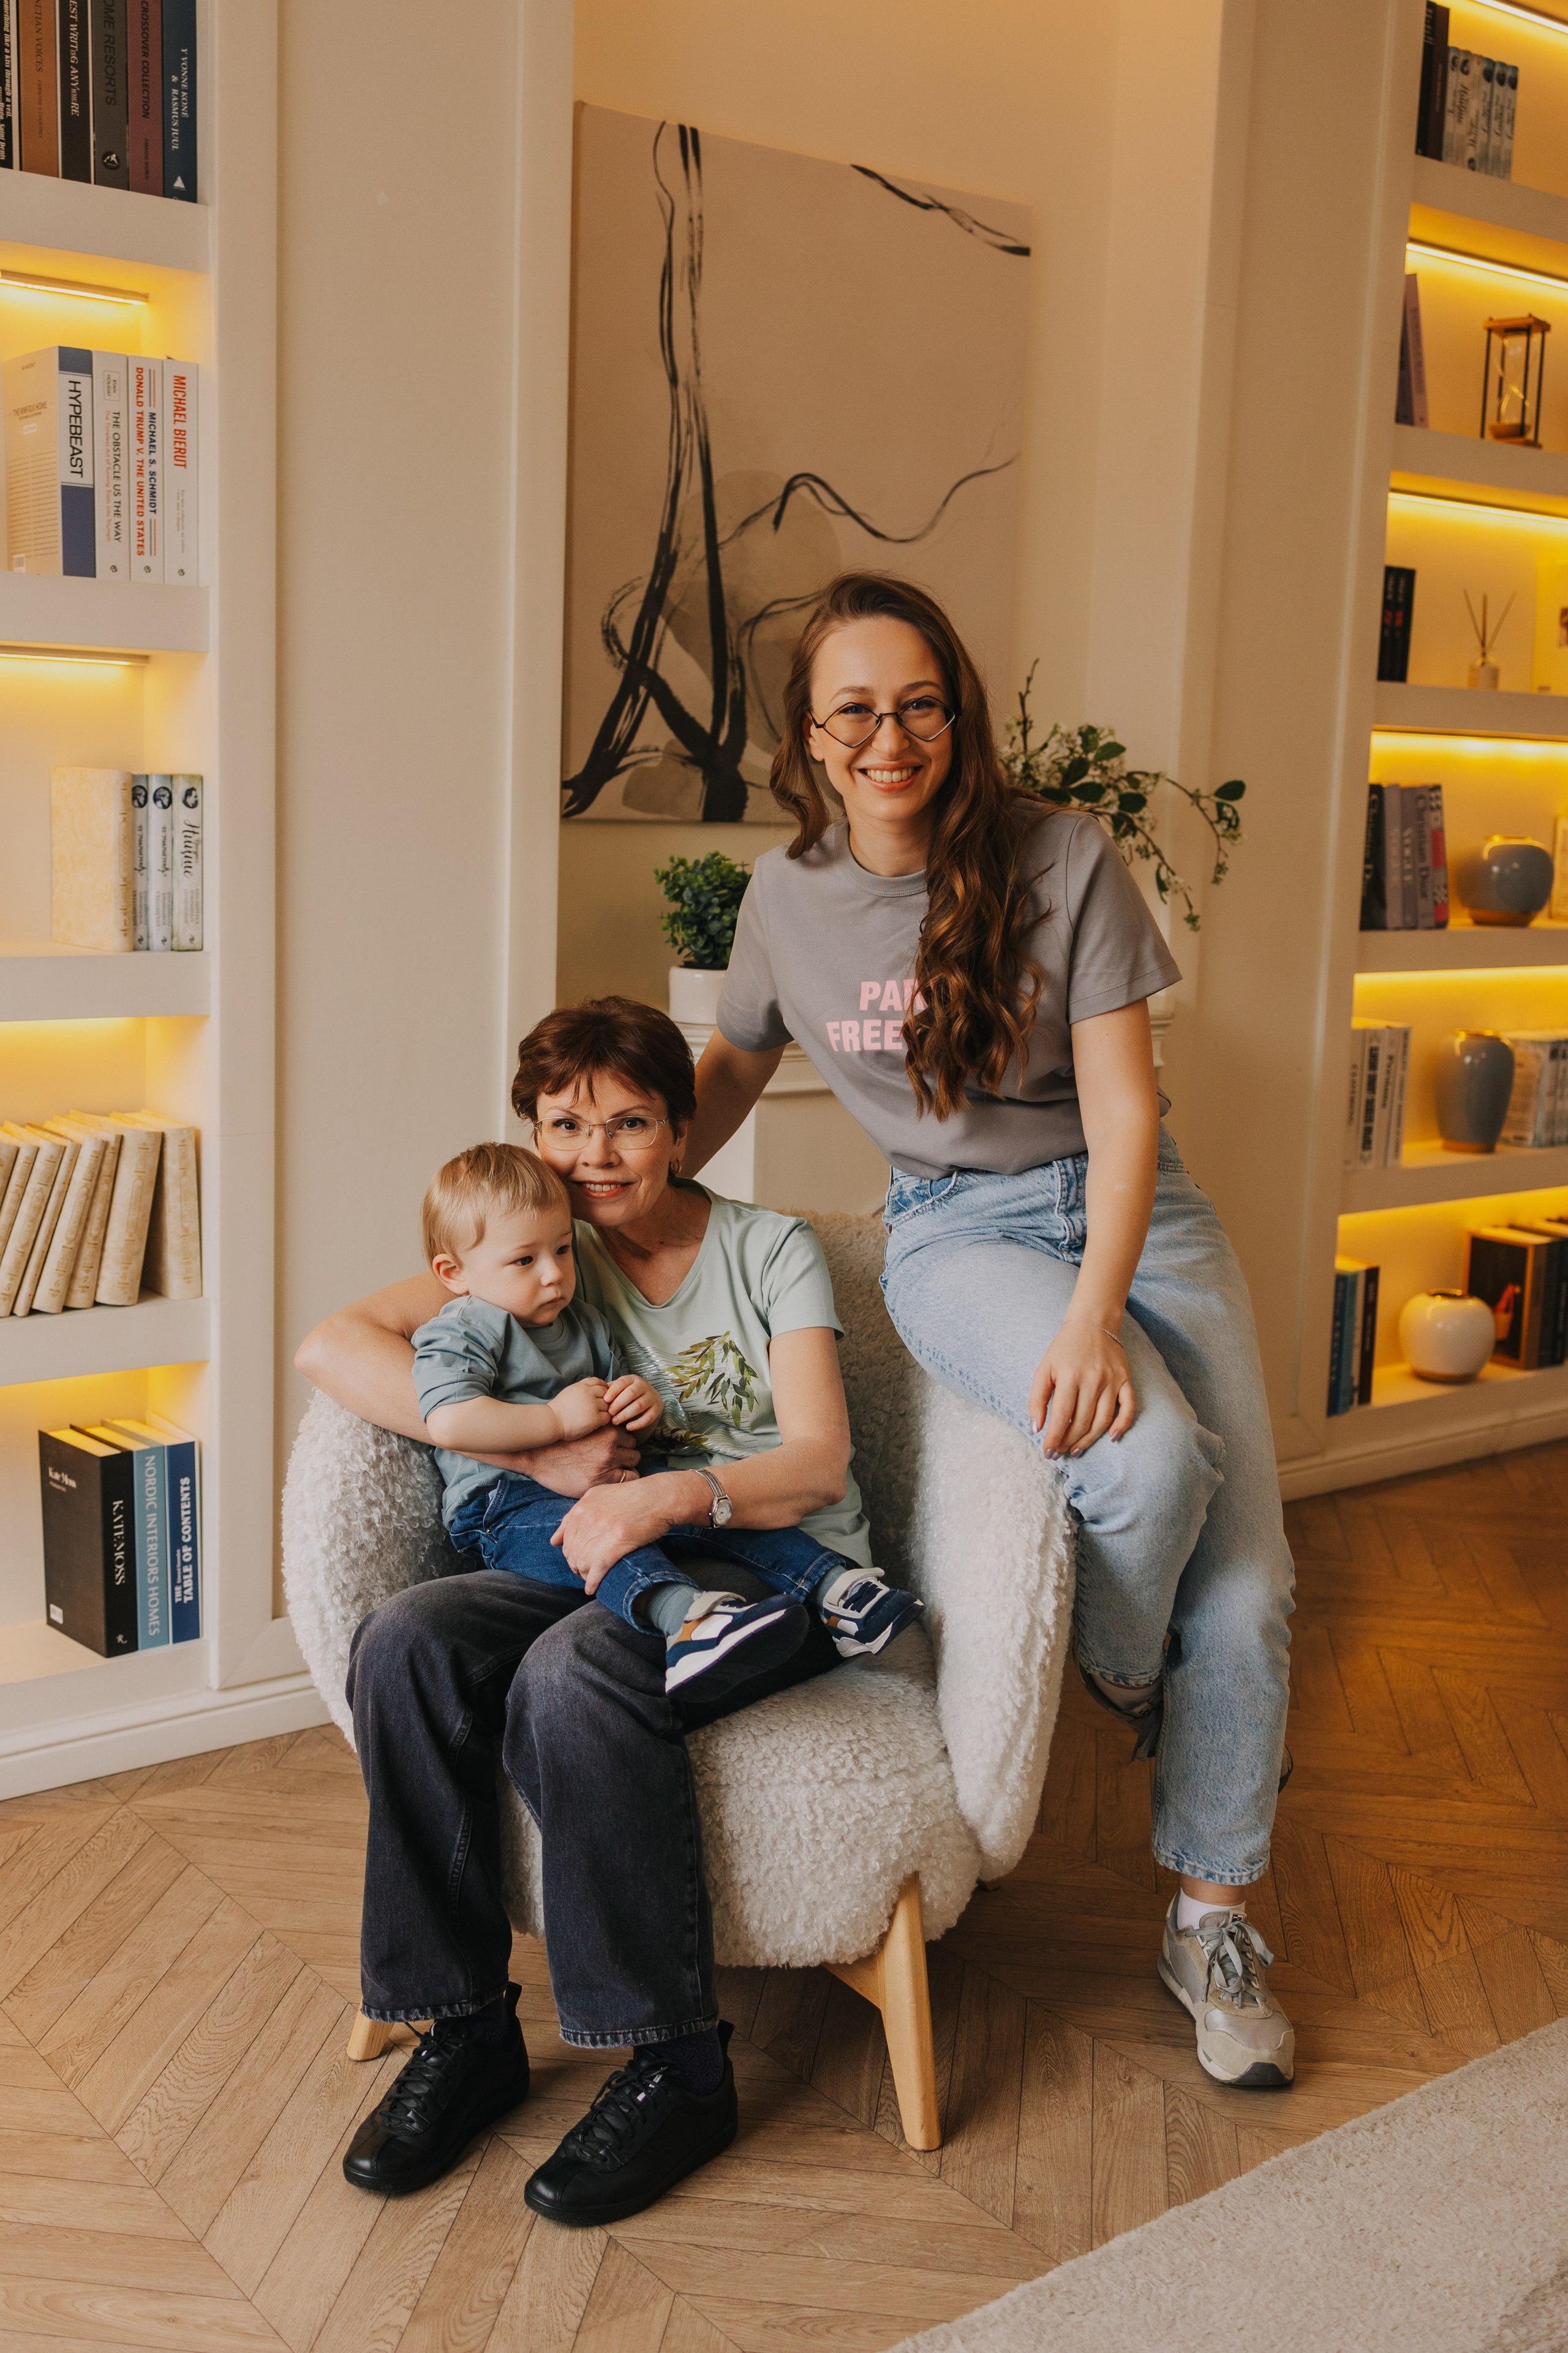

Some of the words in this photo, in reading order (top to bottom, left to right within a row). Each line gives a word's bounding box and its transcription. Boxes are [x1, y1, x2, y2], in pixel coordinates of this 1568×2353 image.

[69, 0, 78, 21] EST
[104, 0, 115, 30] OME
[140, 1, 149, 58] CROSSOVER
[104, 34, 116, 106] RESORTS
[141, 60, 150, 119] COLLECTION
[173, 376, 186, 425] MICHAEL
[69, 380, 83, 478] HYPEBEAST
[173, 429, 186, 469] BIERUT
[149, 459, 156, 467] S.
[113, 484, 121, 497] US
[859, 978, 929, 1011] PAR
[826, 1019, 904, 1052] FREE
[145, 1455, 157, 1510] NORDIC
[180, 1476, 192, 1543] CONTENTS
[146, 1513, 159, 1584] INTERIORS
[182, 1545, 192, 1562] OF
[183, 1564, 194, 1604] TABLE
[148, 1585, 160, 1636] HOMES
